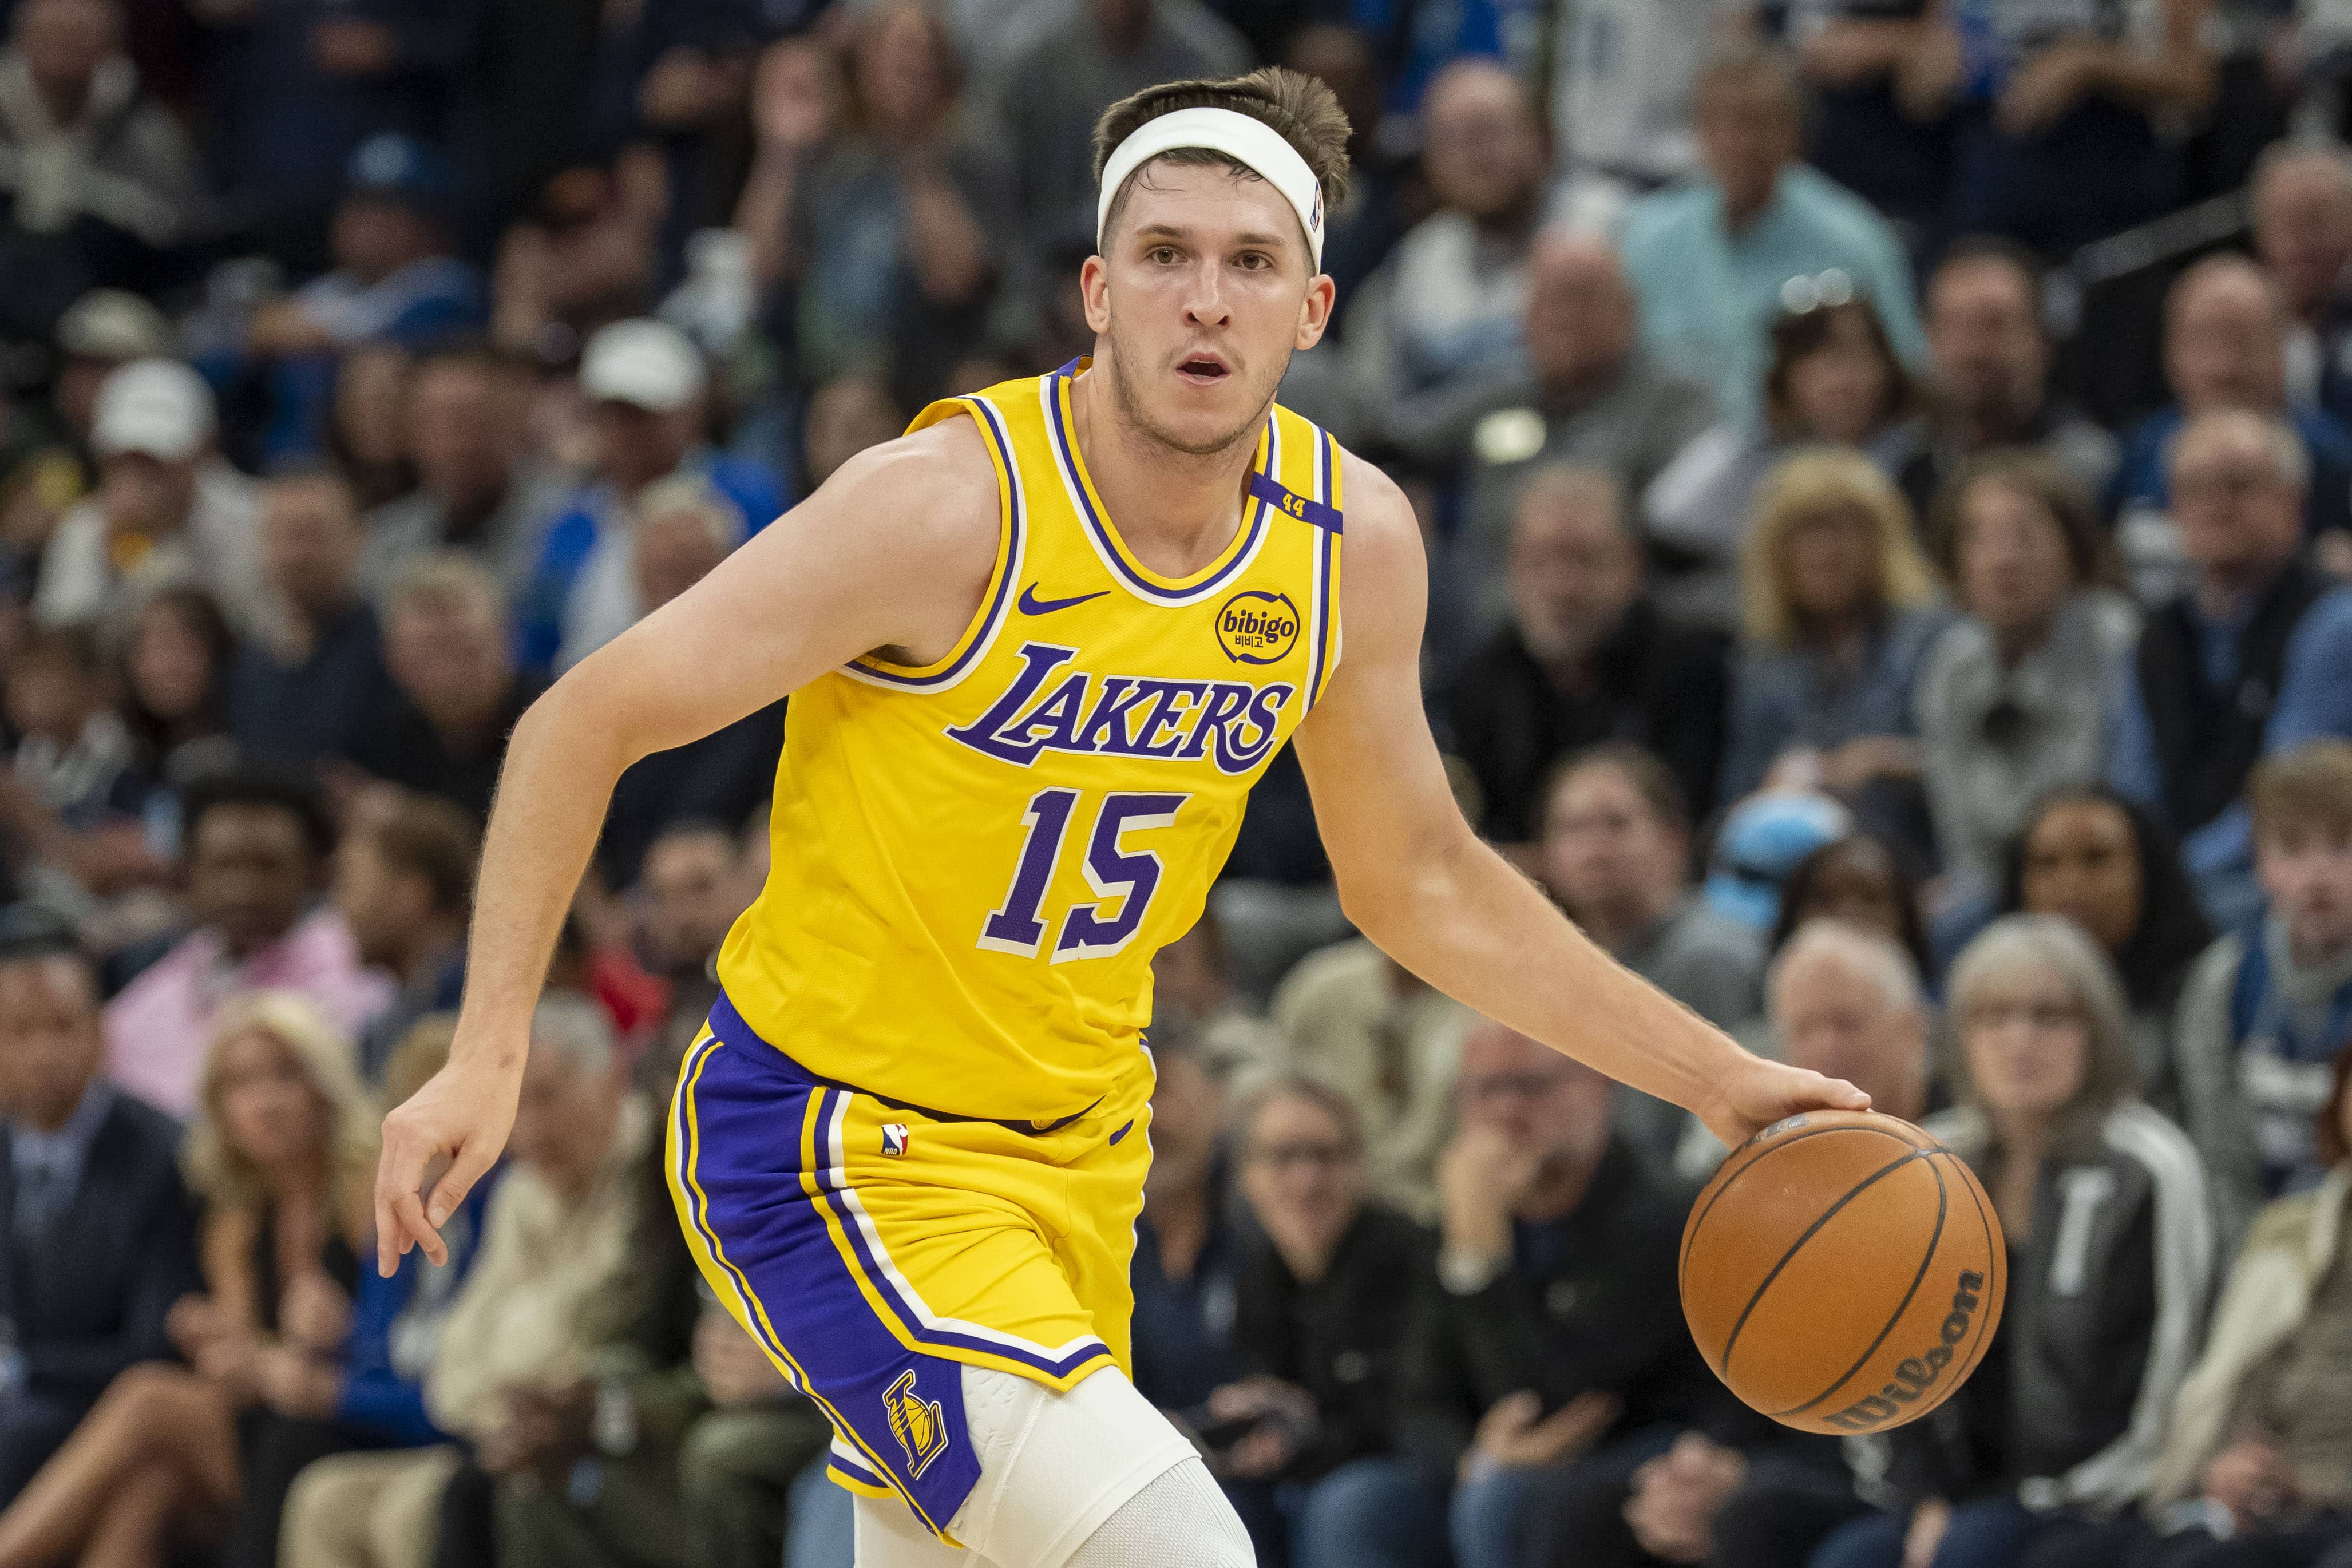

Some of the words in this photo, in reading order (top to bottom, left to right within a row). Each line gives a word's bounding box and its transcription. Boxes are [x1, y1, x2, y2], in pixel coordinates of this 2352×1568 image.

[1282, 493, 1305, 518] 44
[1223, 609, 1294, 644] bibigo
[1235, 635, 1264, 648] 비비고
[944, 640, 1294, 776] LAKERS
[976, 786, 1194, 965] 15
[884, 1147, 897, 1155] NBA
[1822, 1269, 1985, 1430] Wilson
